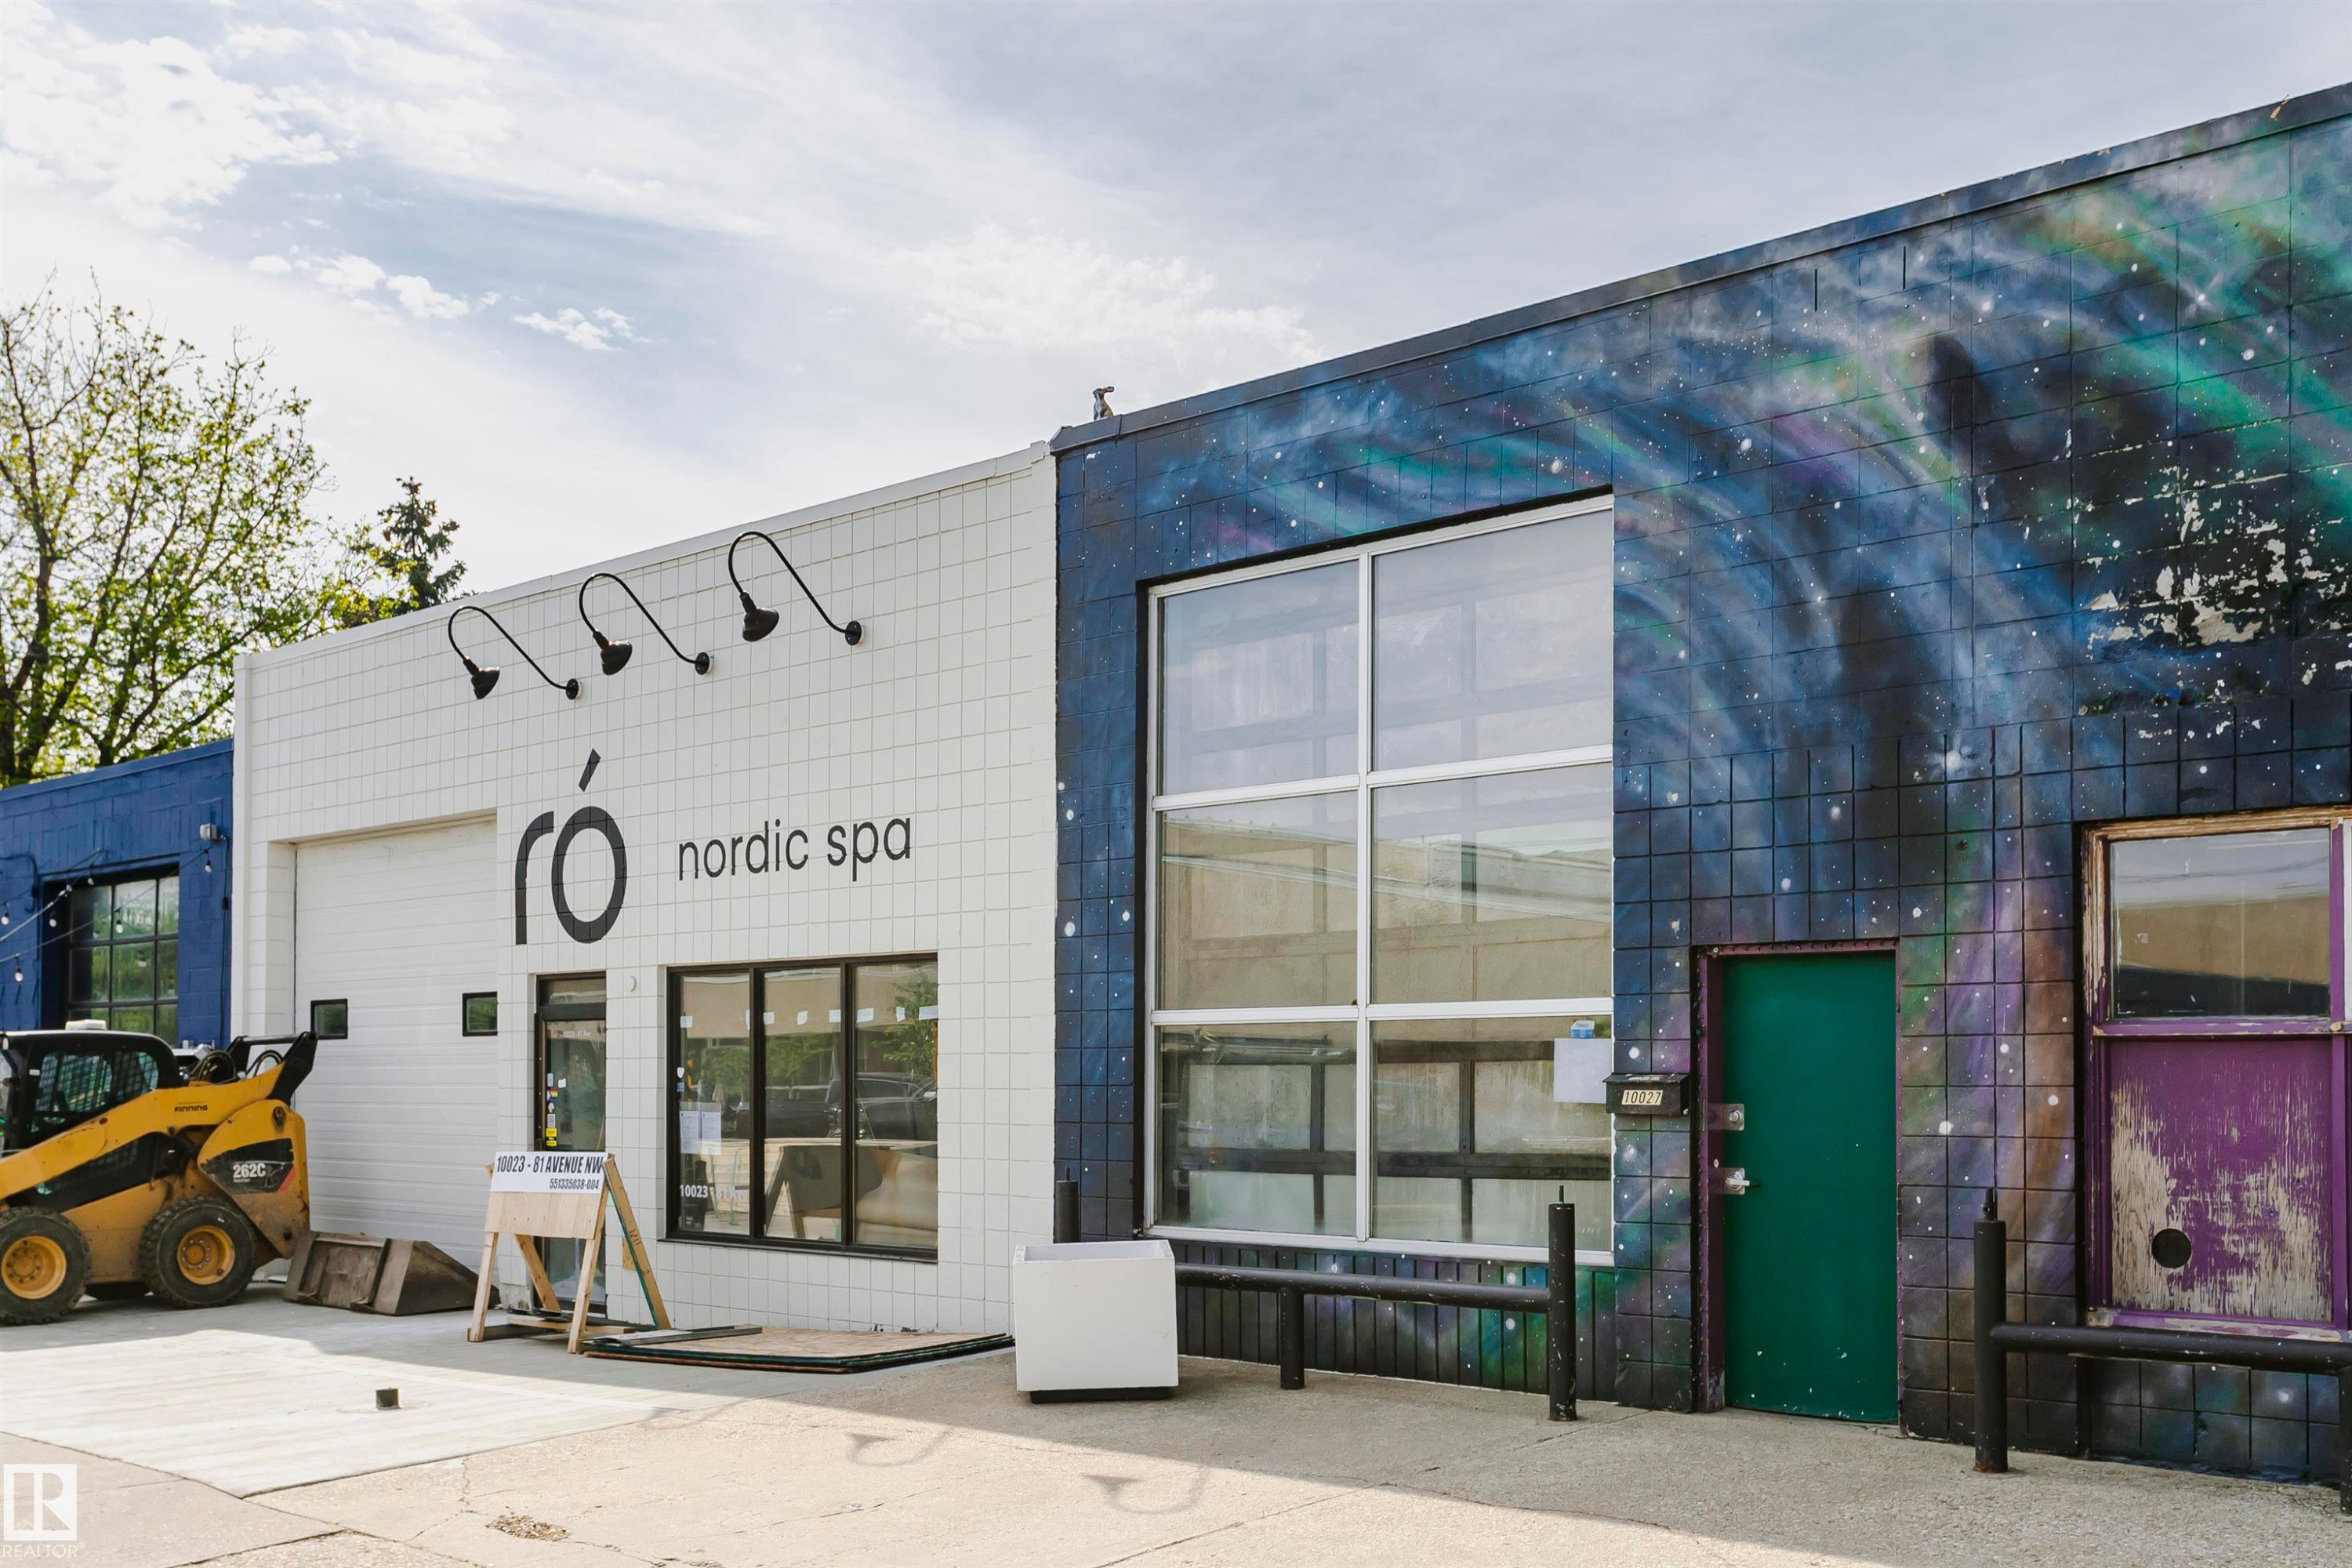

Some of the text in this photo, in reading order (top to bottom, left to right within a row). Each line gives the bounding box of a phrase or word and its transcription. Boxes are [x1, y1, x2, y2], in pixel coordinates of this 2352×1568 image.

[515, 747, 627, 945] ró
[678, 817, 911, 882] nordic spa
[1625, 1091, 1661, 1104] 10027
[233, 1163, 267, 1178] 262C
[497, 1155, 526, 1173] 10023
[533, 1156, 544, 1173] 81
[545, 1156, 584, 1174] AVENUE
[584, 1156, 604, 1174] NW
[549, 1178, 600, 1190] 551335038-004
[680, 1184, 709, 1198] 10023
